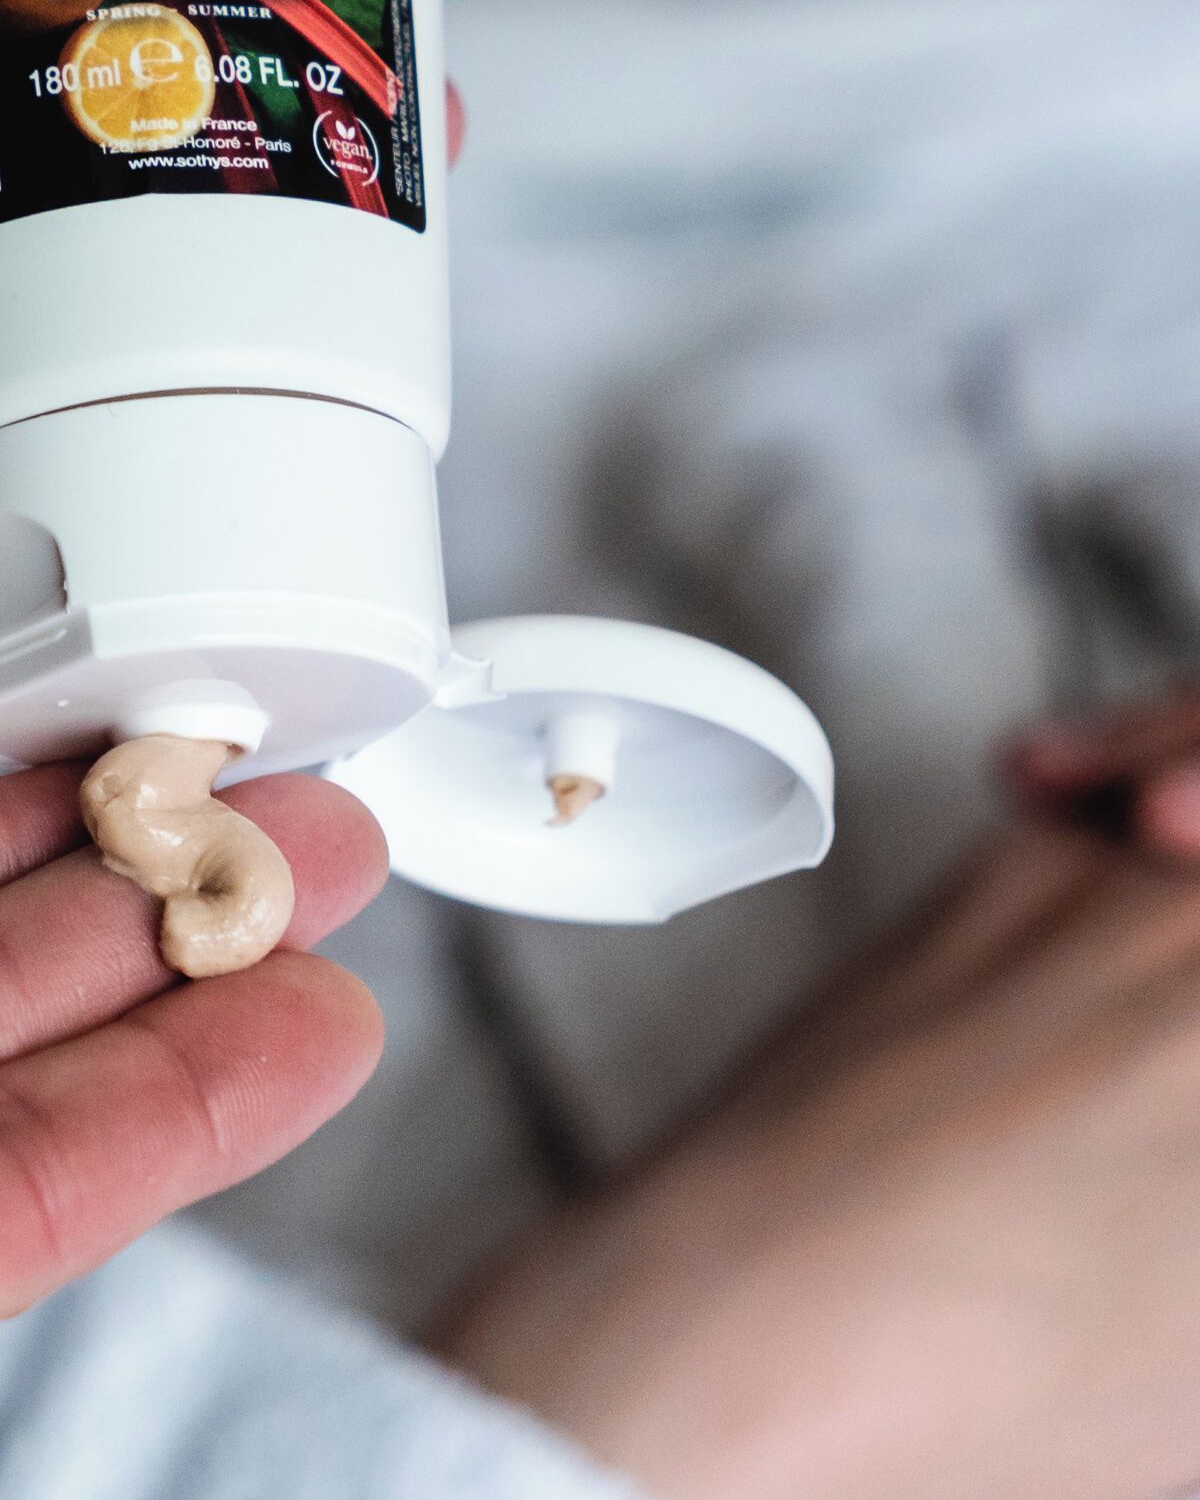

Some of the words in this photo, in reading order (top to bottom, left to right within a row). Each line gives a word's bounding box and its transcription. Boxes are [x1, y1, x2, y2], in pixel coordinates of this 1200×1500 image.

[86, 3, 162, 21] SPRING
[188, 3, 273, 19] SUMMER
[29, 62, 79, 97] 180
[87, 58, 122, 88] ml
[194, 54, 253, 85] 6.08
[258, 56, 300, 88] FL.
[305, 61, 345, 96] OZ
[130, 117, 179, 132] Made
[202, 117, 258, 132] France
[254, 136, 293, 153] Paris
[128, 153, 269, 171] www.sothys.com
